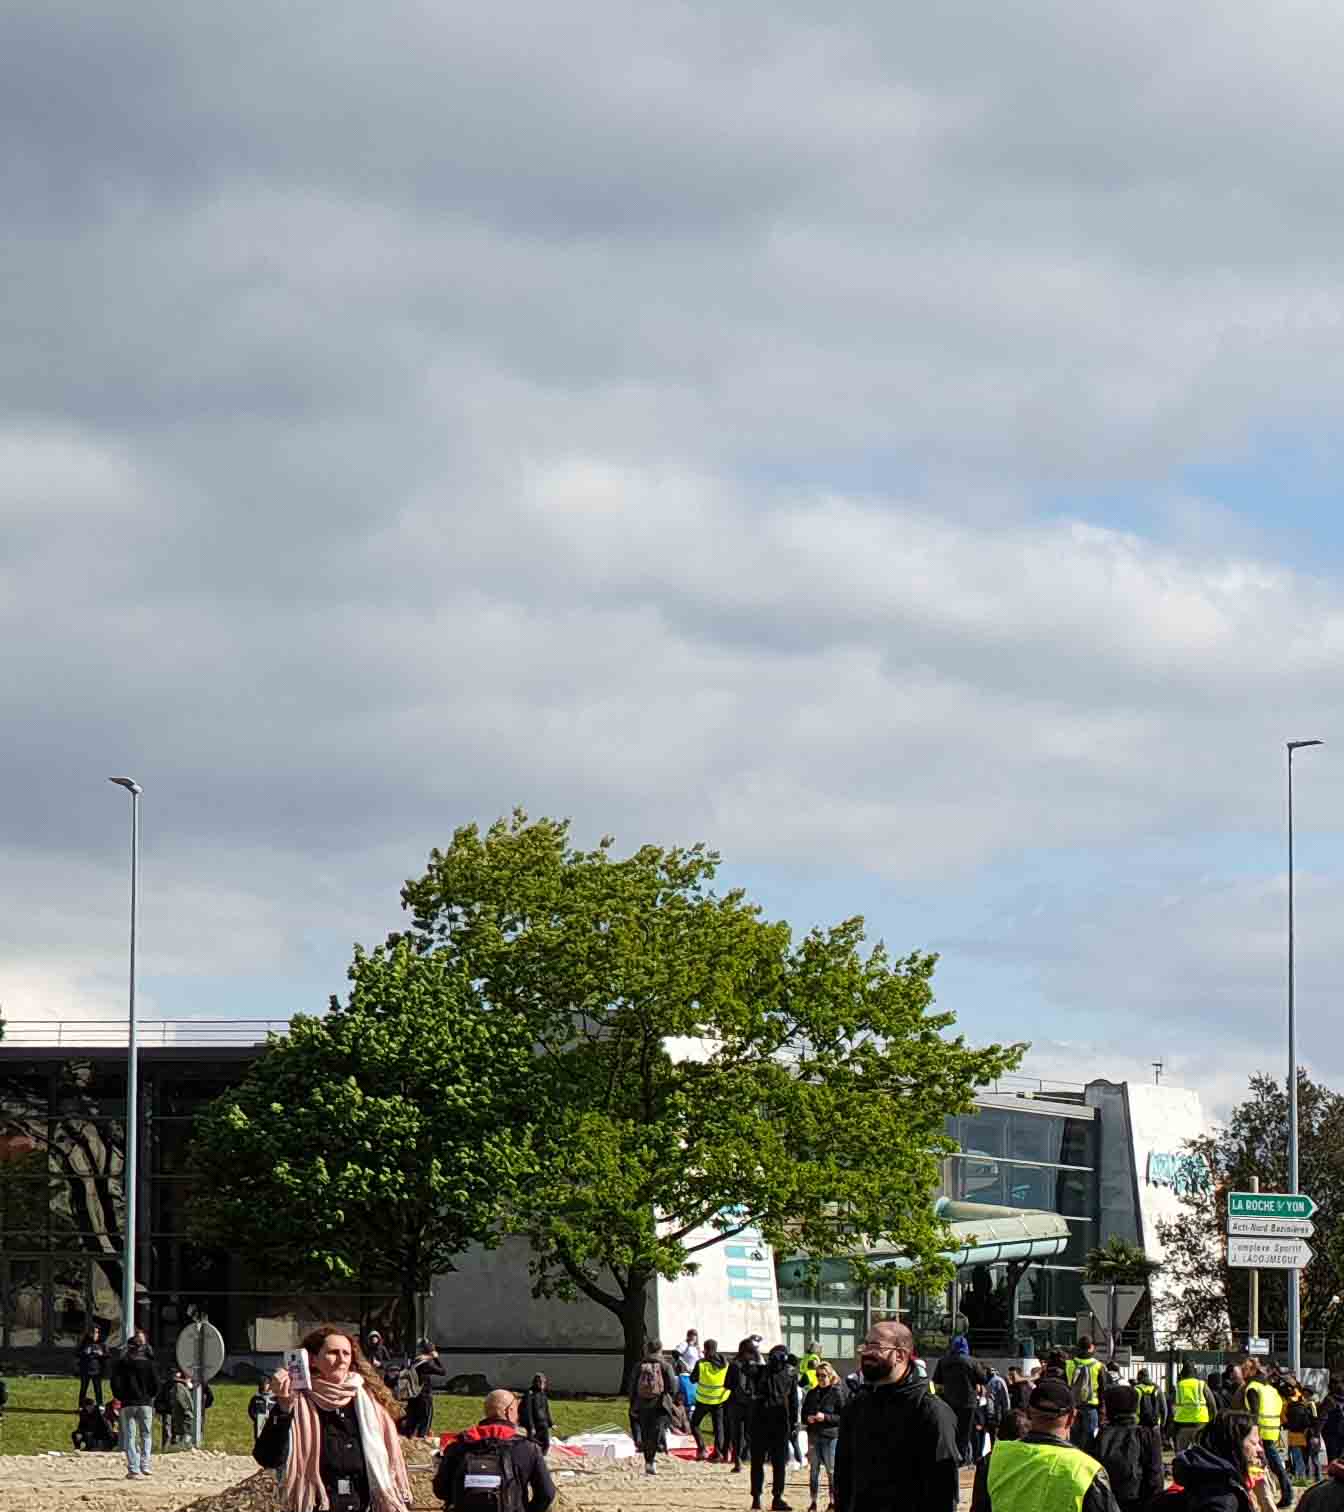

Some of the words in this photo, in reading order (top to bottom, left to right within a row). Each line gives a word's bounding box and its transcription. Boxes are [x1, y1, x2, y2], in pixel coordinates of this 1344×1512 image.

[1232, 1199, 1244, 1210] LA
[1246, 1200, 1275, 1212] ROCHE
[1286, 1201, 1305, 1212] YON
